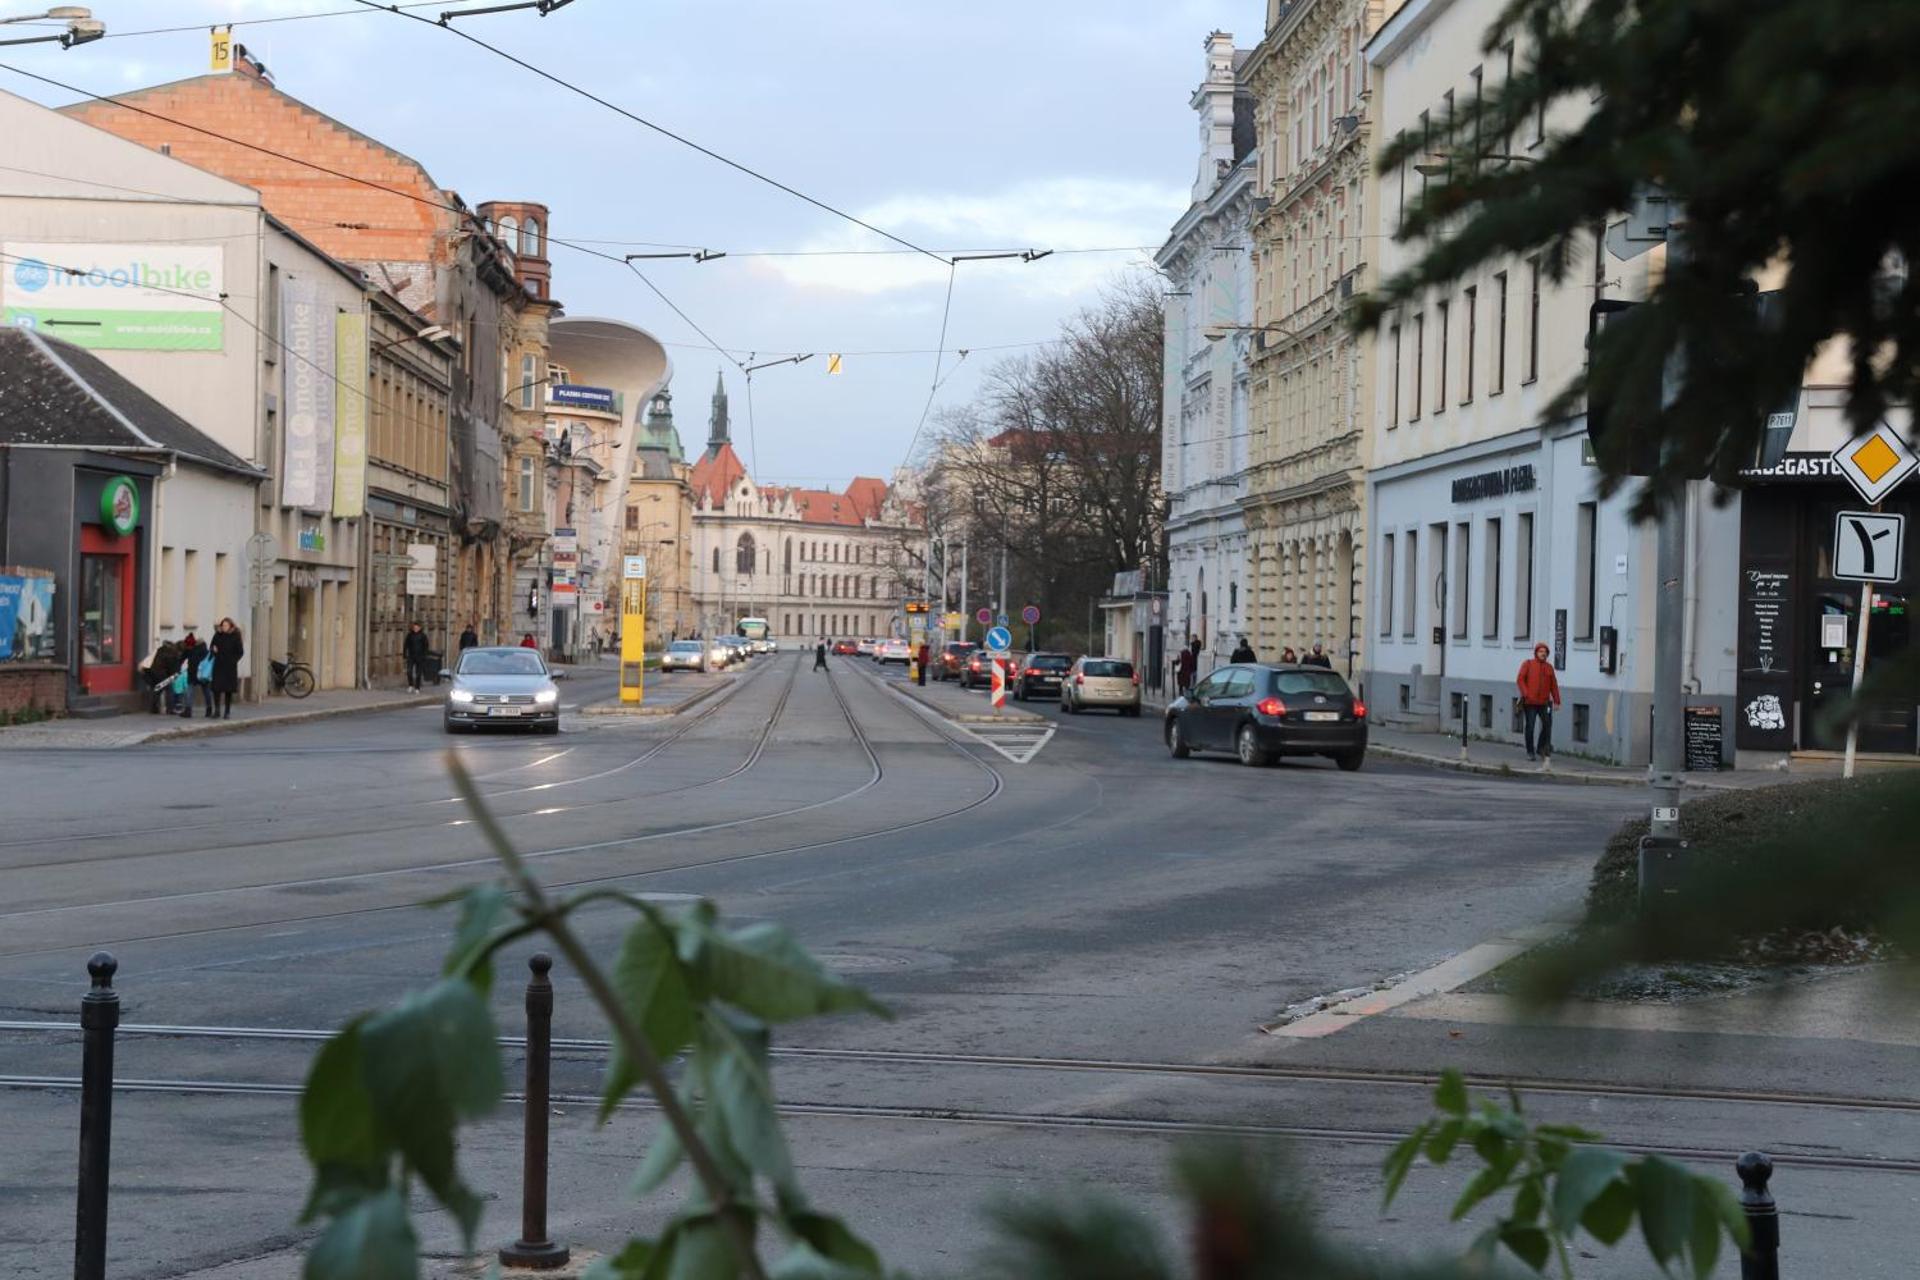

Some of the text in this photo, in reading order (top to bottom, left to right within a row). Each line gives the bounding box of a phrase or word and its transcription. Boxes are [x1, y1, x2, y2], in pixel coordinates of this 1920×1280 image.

[212, 41, 229, 61] 15
[54, 262, 212, 290] moolbike
[1216, 386, 1225, 425] PARKU
[1656, 808, 1676, 818] E D
